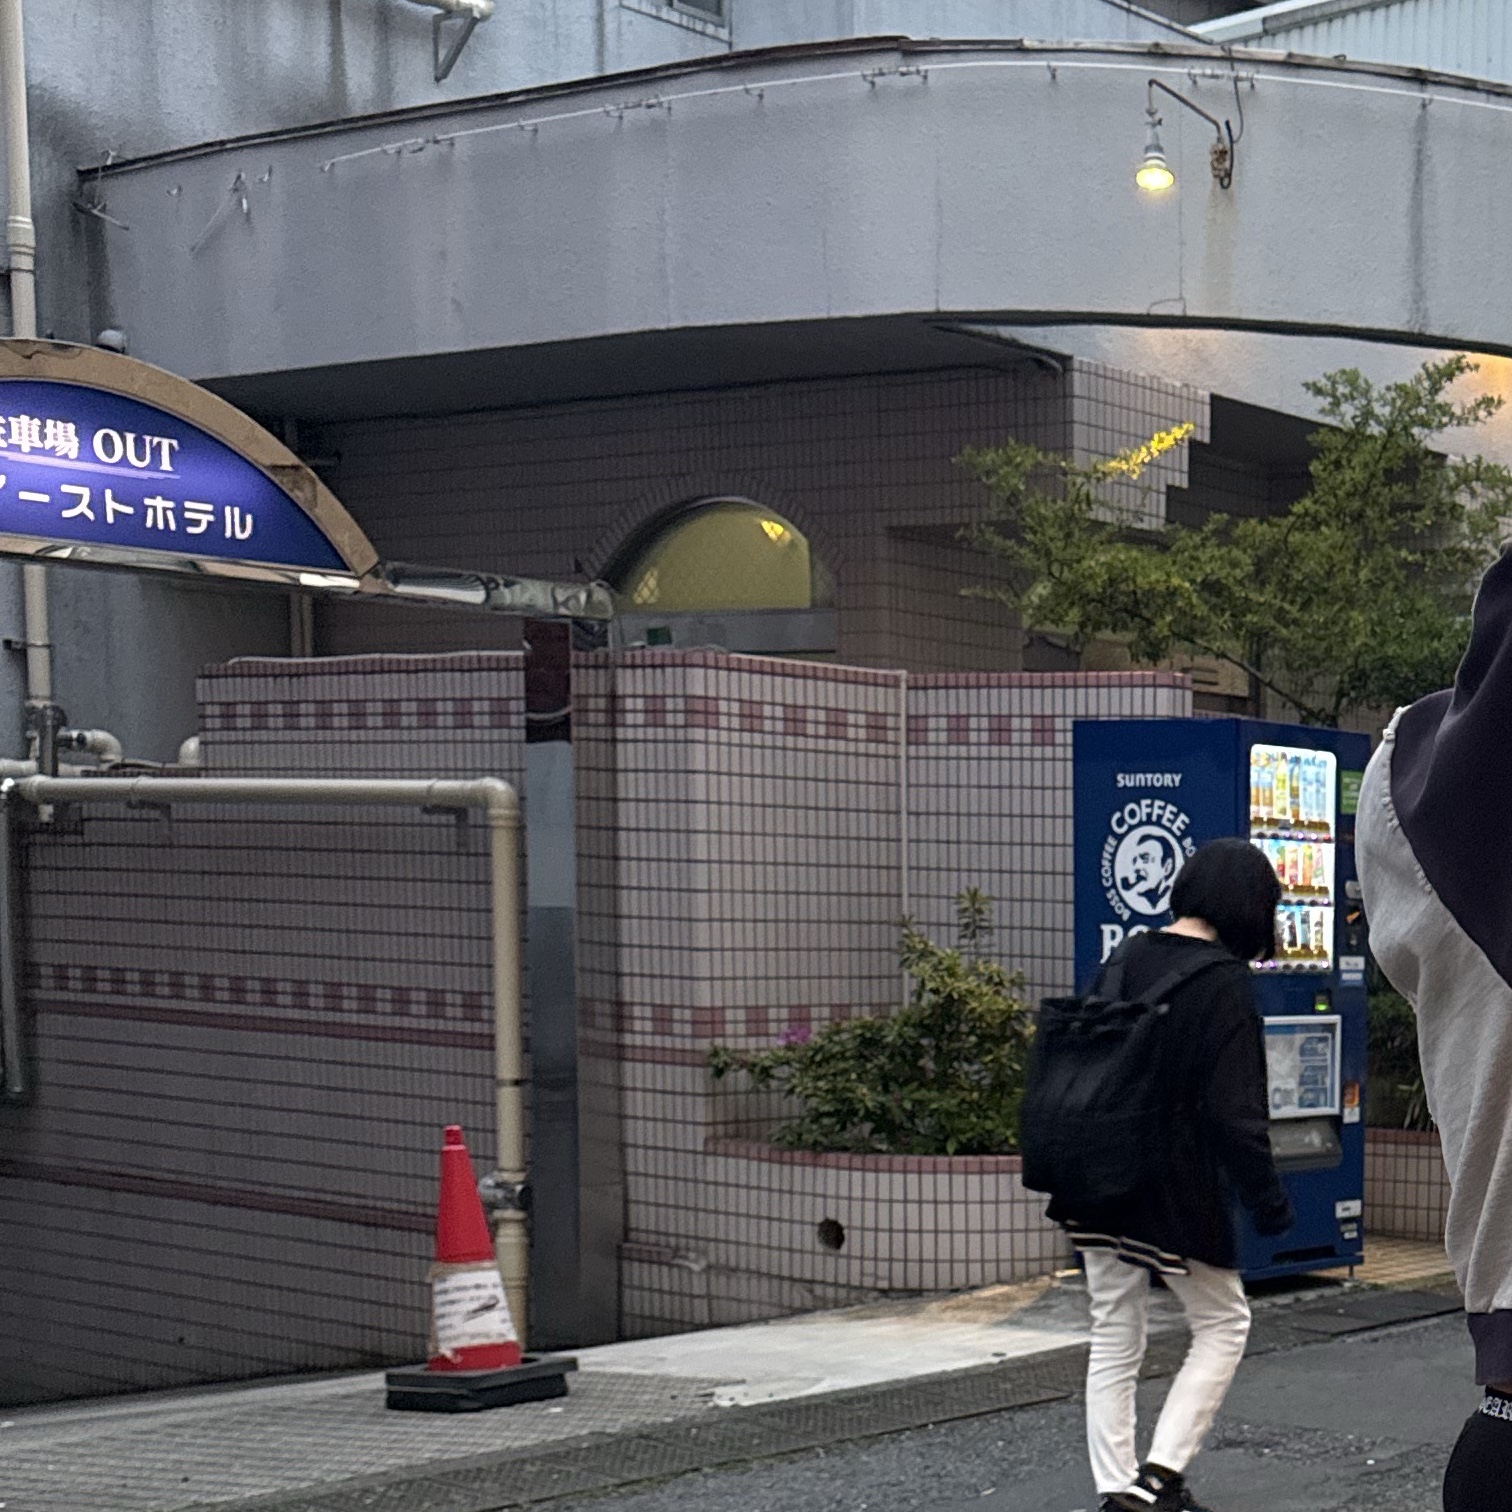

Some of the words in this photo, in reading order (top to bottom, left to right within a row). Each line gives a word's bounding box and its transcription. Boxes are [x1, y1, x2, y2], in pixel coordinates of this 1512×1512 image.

[92, 427, 180, 472] OUT
[1110, 799, 1191, 837] COFFEE
[1101, 834, 1119, 888] COFFEE
[1106, 888, 1132, 922] BOSS
